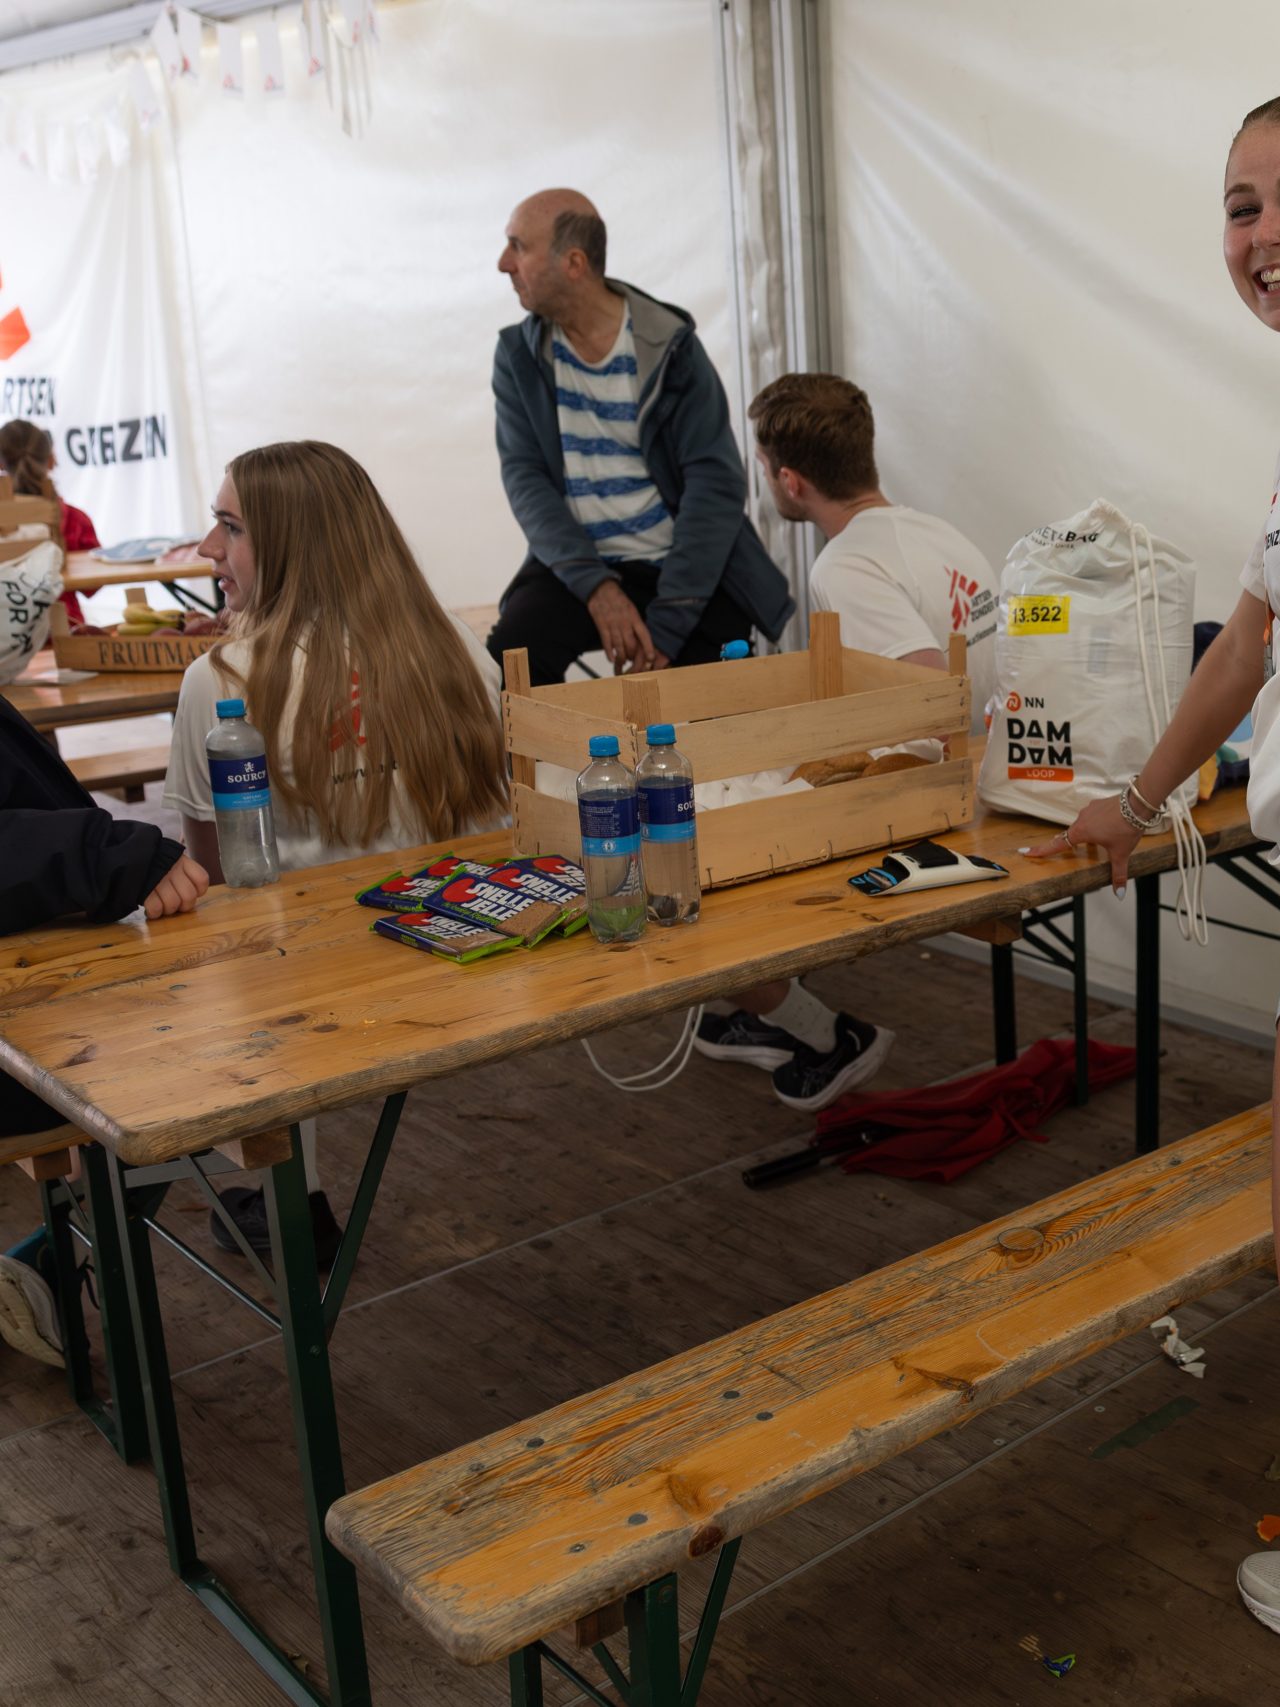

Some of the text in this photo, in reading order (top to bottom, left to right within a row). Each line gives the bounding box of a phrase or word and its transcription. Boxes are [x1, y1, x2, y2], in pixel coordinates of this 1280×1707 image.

[0, 376, 56, 416] RTSEN
[1012, 606, 1062, 624] 13.522
[97, 640, 213, 665] FRUITMAS
[1025, 697, 1044, 709] NN
[1007, 718, 1071, 743] DAM
[1008, 742, 1073, 766] DAM
[227, 770, 266, 784] SOURCY
[1027, 769, 1056, 778] LOOP
[461, 897, 520, 921] JELLE
[465, 882, 536, 912] SNELLE
